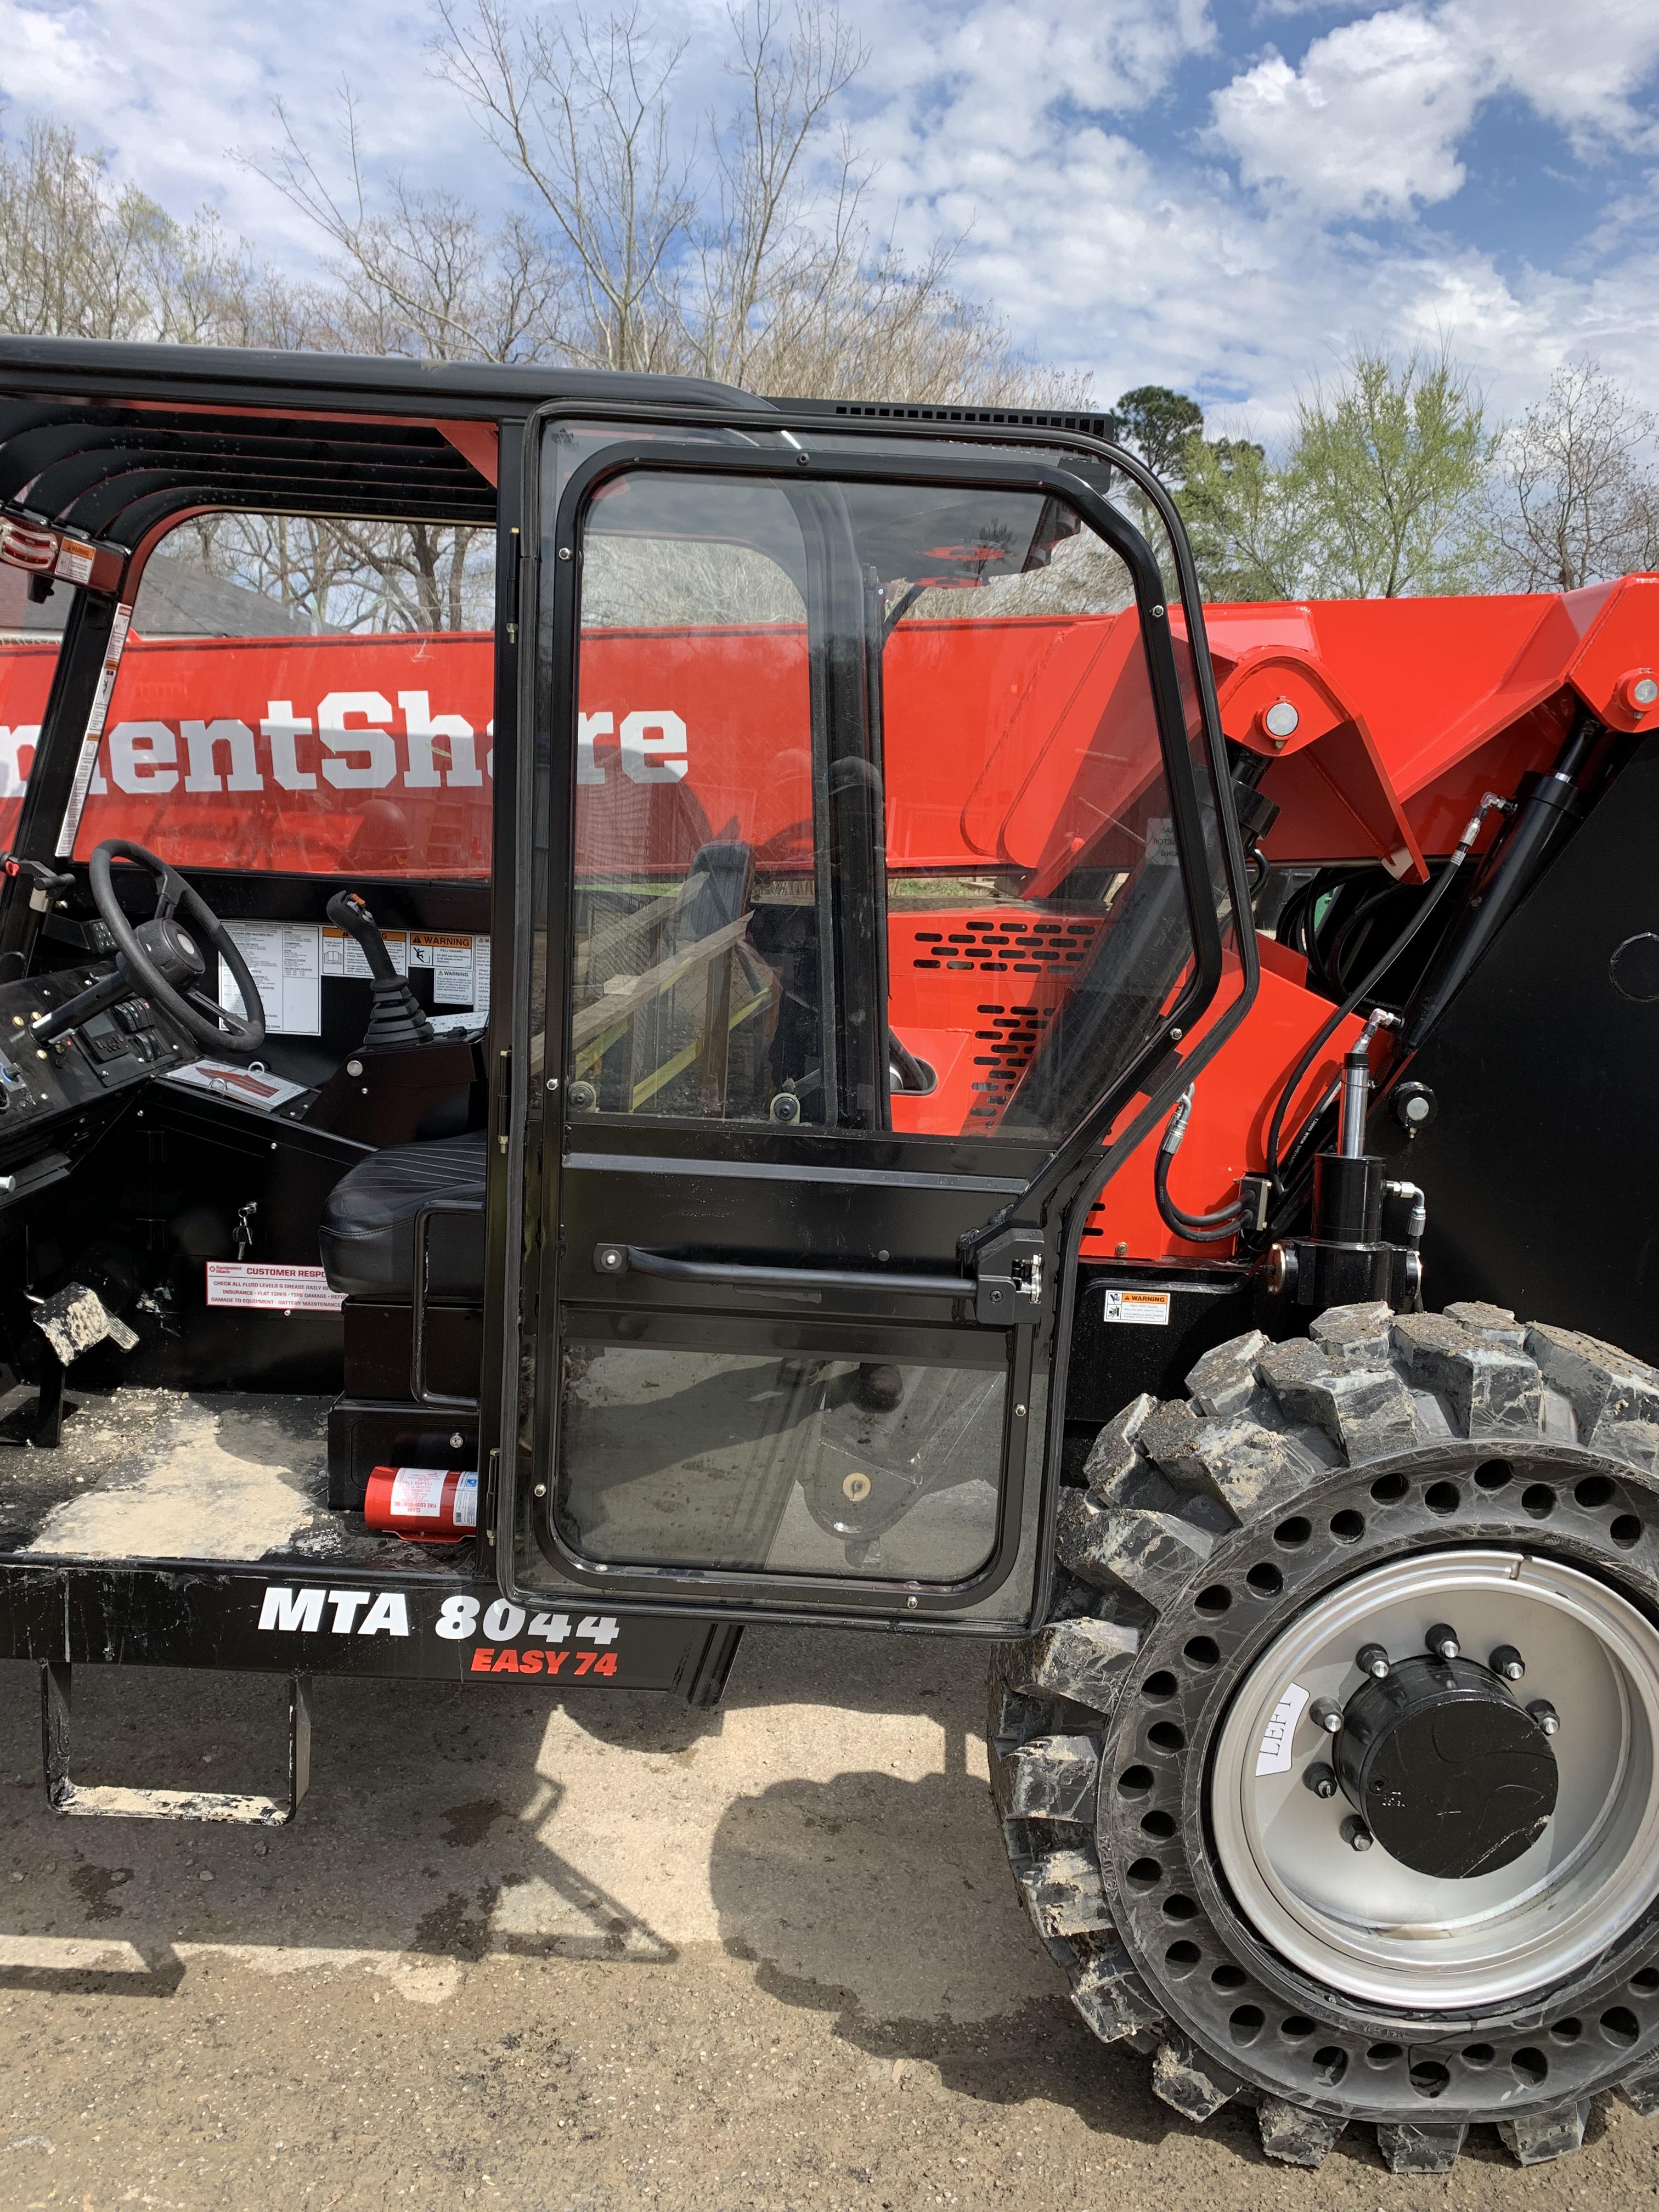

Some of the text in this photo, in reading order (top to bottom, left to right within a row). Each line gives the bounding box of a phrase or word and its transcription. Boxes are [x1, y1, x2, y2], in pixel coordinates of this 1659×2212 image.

[424, 936, 470, 946] WARNING
[246, 1268, 296, 1277] CUSTOMER
[257, 1587, 620, 1645] MTA 8044
[471, 1647, 618, 1677] EASY 74
